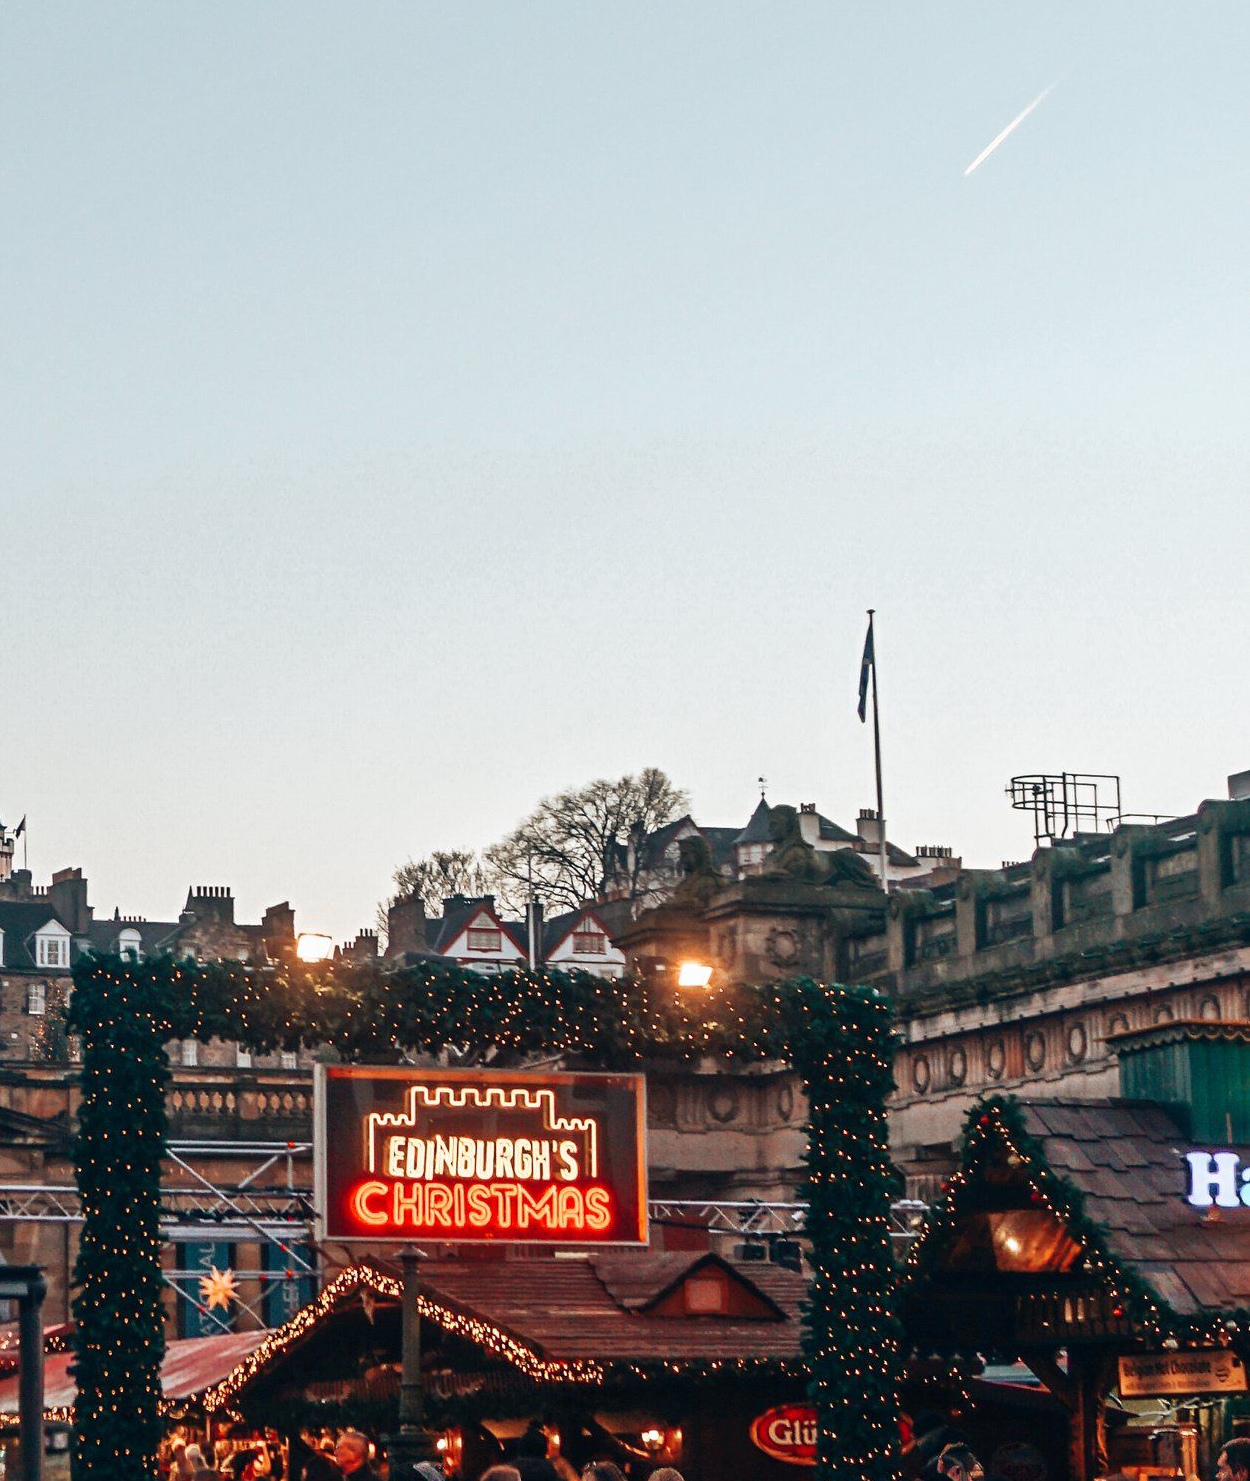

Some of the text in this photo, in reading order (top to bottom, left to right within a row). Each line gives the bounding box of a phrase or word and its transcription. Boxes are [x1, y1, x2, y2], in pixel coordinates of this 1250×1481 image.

[388, 1134, 578, 1181] EDINBURGH'S
[1185, 1151, 1250, 1208] H
[353, 1182, 611, 1229] CHRISTMAS
[768, 1418, 818, 1446] Glü
